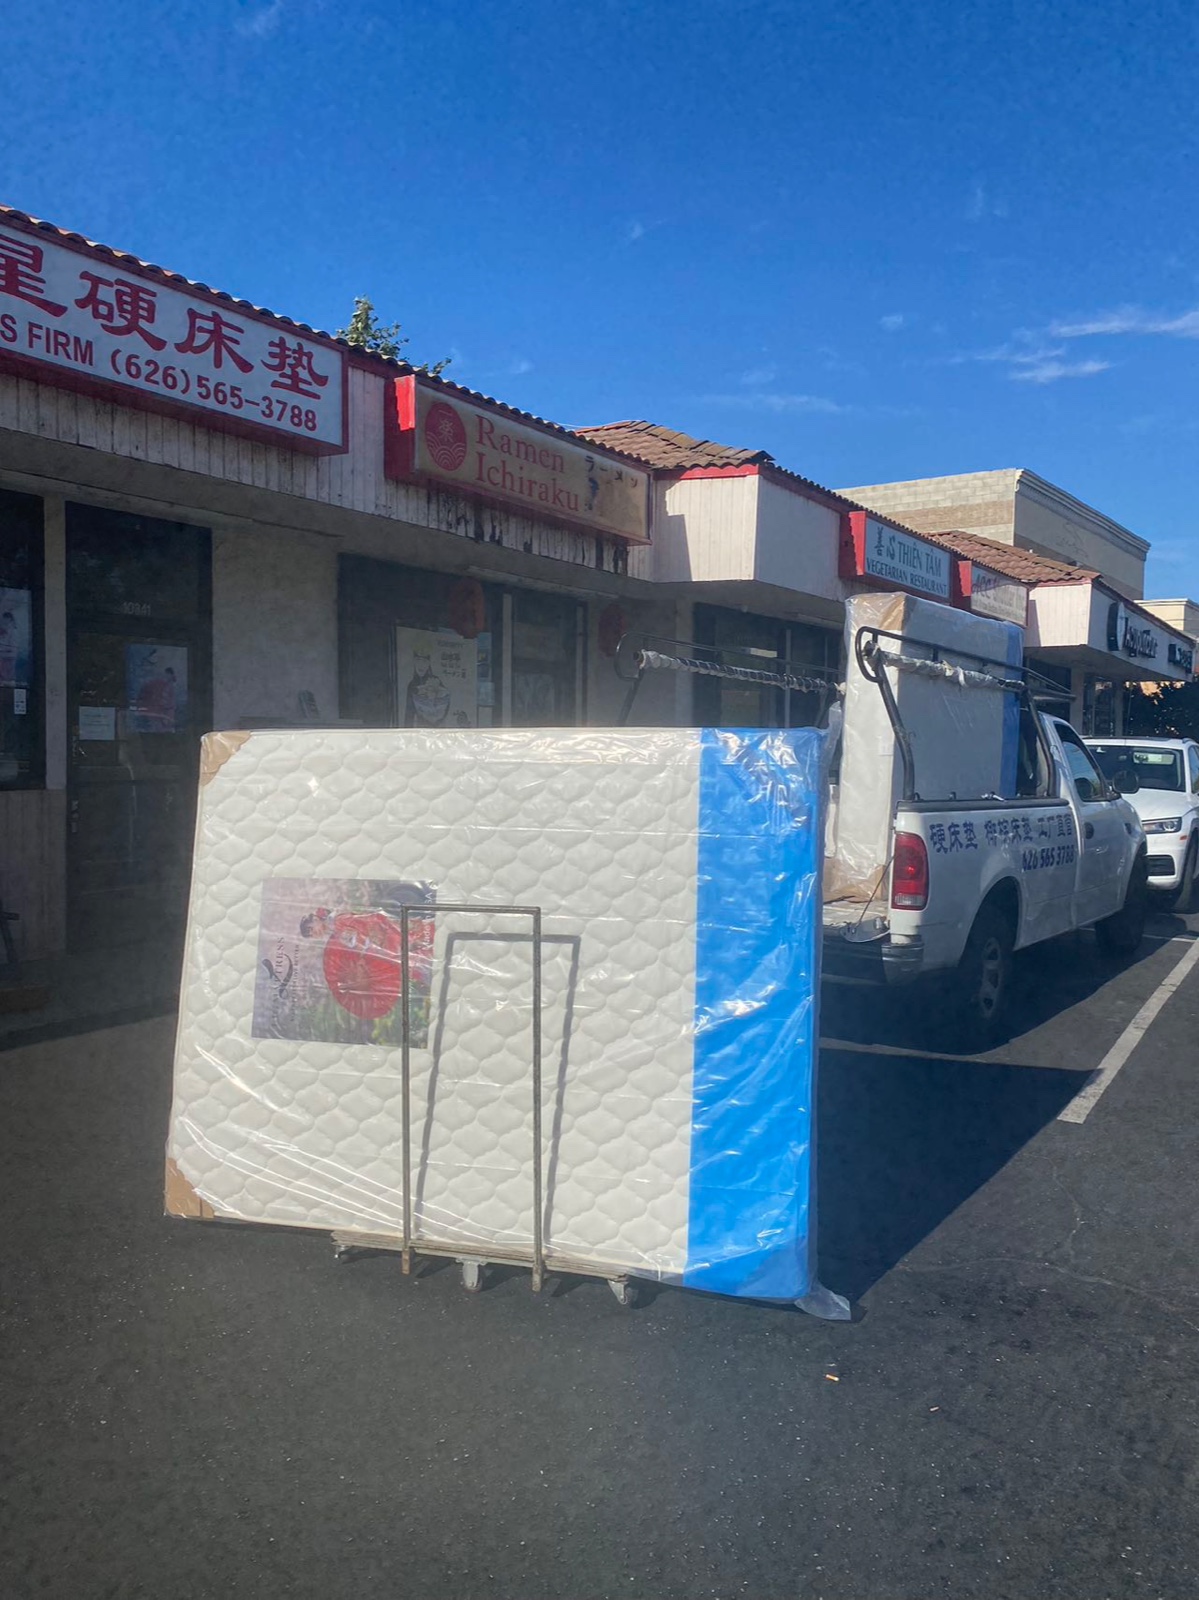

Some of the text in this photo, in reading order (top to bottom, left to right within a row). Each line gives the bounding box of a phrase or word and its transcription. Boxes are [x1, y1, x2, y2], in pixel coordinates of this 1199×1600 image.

[28, 321, 94, 367] FIRM
[475, 414, 565, 473] Ramen
[475, 452, 580, 512] Ichiraku
[866, 557, 948, 596] VEGETARIAN RESTAURANT
